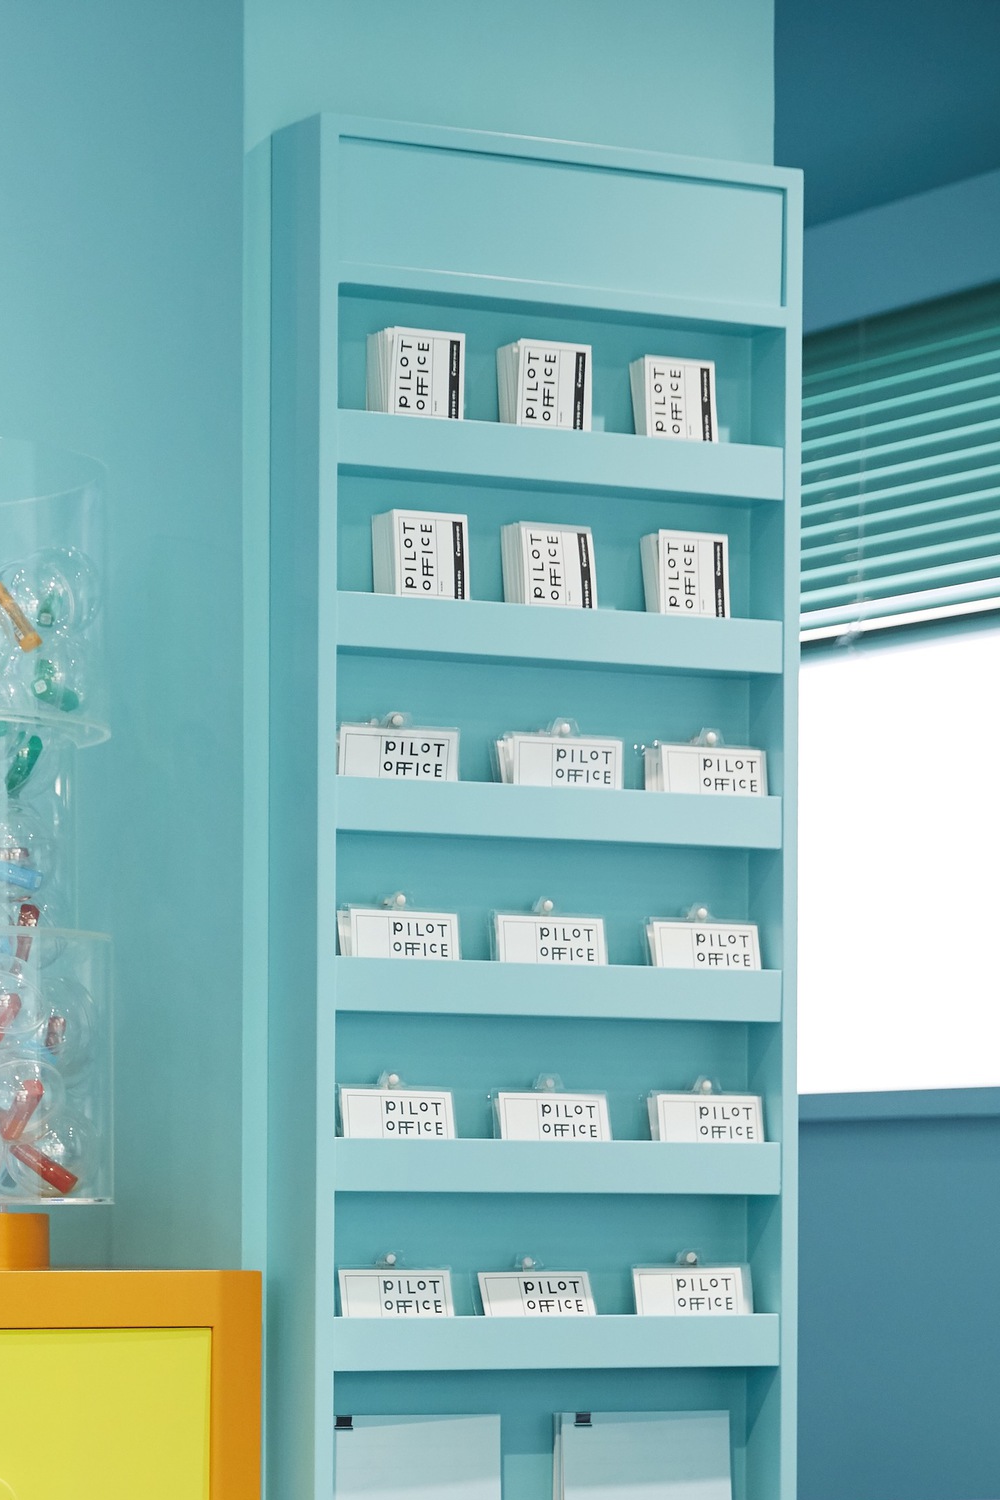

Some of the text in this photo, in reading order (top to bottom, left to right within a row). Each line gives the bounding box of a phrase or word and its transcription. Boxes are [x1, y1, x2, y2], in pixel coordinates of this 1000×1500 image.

[398, 339, 413, 409] PILOT
[416, 342, 430, 411] OFFICE
[525, 351, 540, 420] PILOT
[542, 354, 557, 422] OFFICE
[653, 367, 667, 433] PILOT
[669, 370, 683, 434] OFFICE
[402, 522, 417, 589] PILOT
[420, 524, 434, 591] OFFICE
[529, 534, 546, 599] PILOT
[546, 536, 561, 601] OFFICE
[667, 542, 680, 608] PILOT
[683, 544, 696, 609] OFFICE
[384, 740, 445, 758] PILOT
[556, 748, 613, 765] PILOT
[383, 761, 443, 778] OFFICE
[702, 758, 757, 774] PILOT
[555, 768, 611, 785] OFFICE
[703, 777, 758, 793] OFFICE
[392, 921, 448, 938] PILOT
[539, 927, 594, 942] PILOT
[695, 933, 749, 948] PILOT
[393, 941, 448, 958] OFFICE
[539, 946, 595, 962] OFFICE
[696, 952, 751, 967] OFFICE
[385, 1100, 442, 1116] PILOT
[541, 1103, 596, 1119] PILOT
[698, 1106, 753, 1120] PILOT
[385, 1120, 443, 1136] OFFICE
[542, 1123, 598, 1138] OFFICE
[699, 1125, 754, 1140] OFFICE
[383, 1280, 440, 1294] PILOT
[523, 1280, 580, 1295] PILOT
[676, 1277, 732, 1292] PILOT
[384, 1299, 443, 1314] OFFICE
[526, 1299, 584, 1313] OFFICE
[677, 1296, 733, 1311] OFFICE
